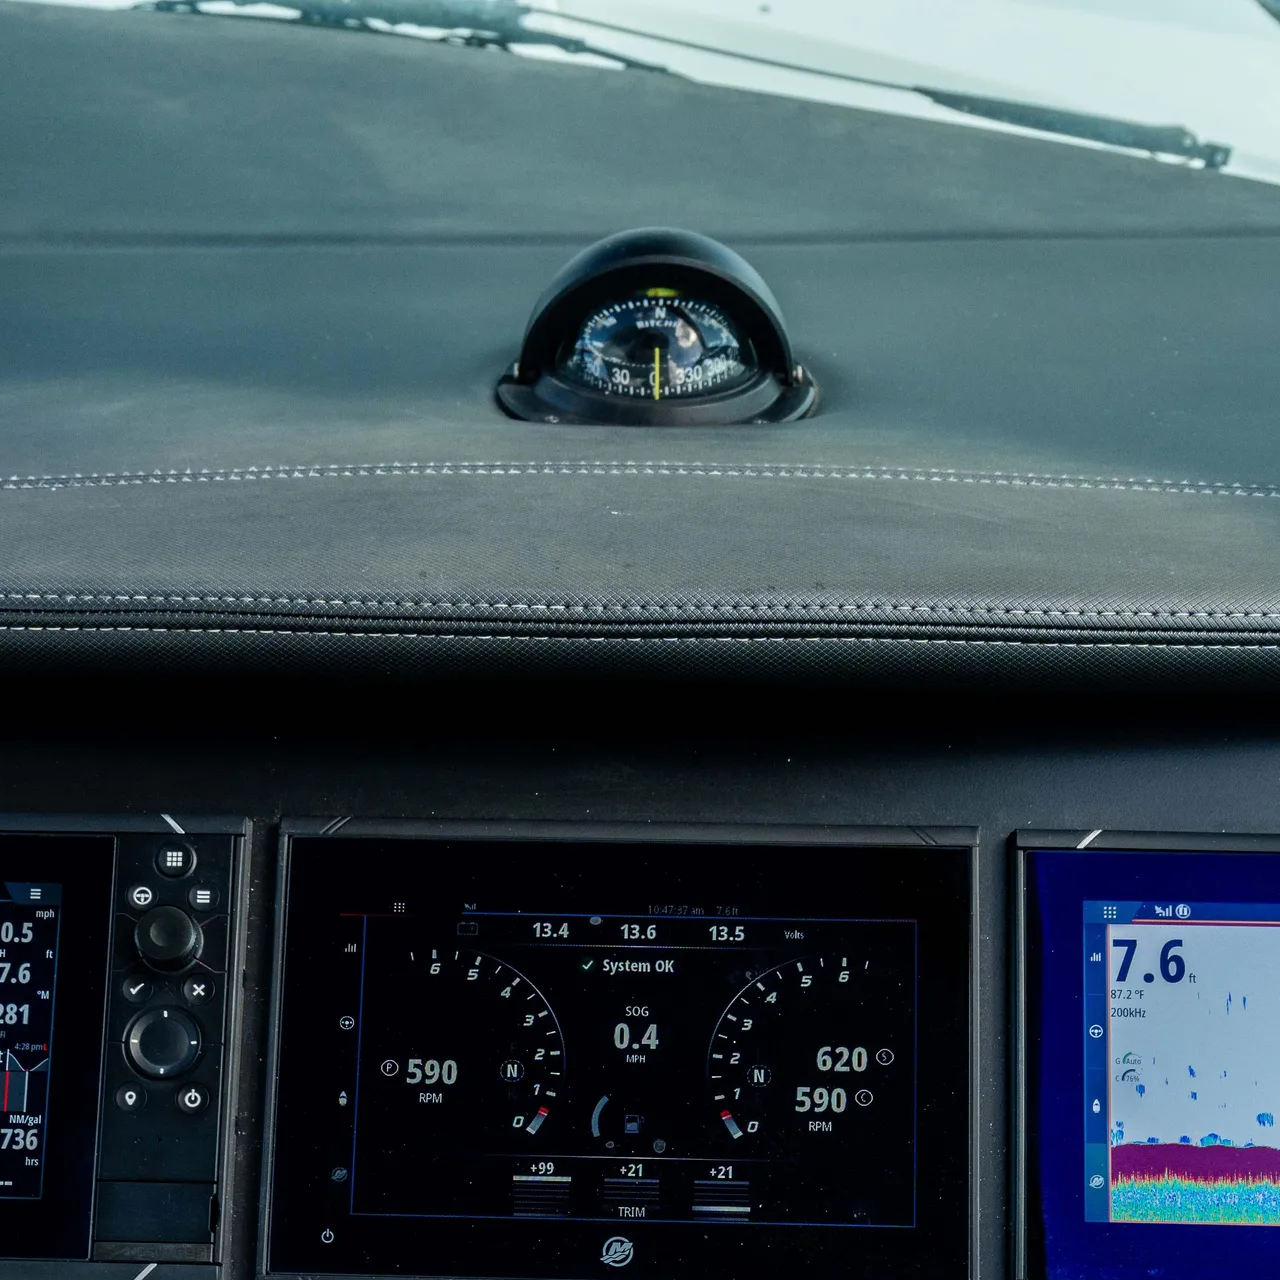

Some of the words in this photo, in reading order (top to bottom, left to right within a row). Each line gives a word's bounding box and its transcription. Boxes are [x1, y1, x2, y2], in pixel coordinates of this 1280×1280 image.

[655, 307, 666, 319] N
[612, 367, 630, 385] 30
[675, 364, 702, 384] 330
[36, 909, 55, 920] mph
[1, 922, 33, 943] 0.5
[532, 922, 570, 938] 13.4
[620, 924, 657, 940] 13.6
[708, 926, 745, 942] 13.5
[784, 929, 805, 940] Volts
[46, 949, 53, 959] ft
[603, 959, 651, 976] System
[655, 960, 674, 973] OK
[1112, 939, 1186, 984] 7.6
[1189, 973, 1197, 984] ft
[430, 963, 441, 975] 6
[467, 968, 479, 981] 5
[800, 975, 813, 987] 5
[839, 971, 850, 983] 6
[500, 986, 512, 998] 4
[766, 992, 777, 1004] 4
[1110, 989, 1132, 1000] 87.2
[1134, 989, 1145, 999] °F
[625, 1006, 649, 1017] SOG
[1110, 1007, 1146, 1018] 200kHz
[523, 1014, 535, 1026] 3
[741, 1019, 753, 1031] 3
[614, 1022, 659, 1050] 0.4
[14, 1042, 30, 1050] 4:28
[534, 1048, 545, 1060] 2
[626, 1054, 646, 1064] MPH
[729, 1052, 741, 1064] 2
[816, 1046, 868, 1072] 620
[1126, 1057, 1142, 1065] Auto
[406, 1059, 458, 1084] 590
[533, 1083, 541, 1096] 1
[733, 1087, 741, 1100] 1
[419, 1093, 443, 1103] RPM
[795, 1086, 847, 1113] 590
[9, 1115, 42, 1126] NM/gal
[512, 1115, 524, 1128] 0
[809, 1121, 832, 1132] RPM
[747, 1121, 759, 1133] 0
[25, 1156, 39, 1166] hrs
[530, 1162, 554, 1175] +99
[620, 1163, 643, 1177] +21
[709, 1165, 733, 1179] +21
[618, 1206, 646, 1218] TRIM
